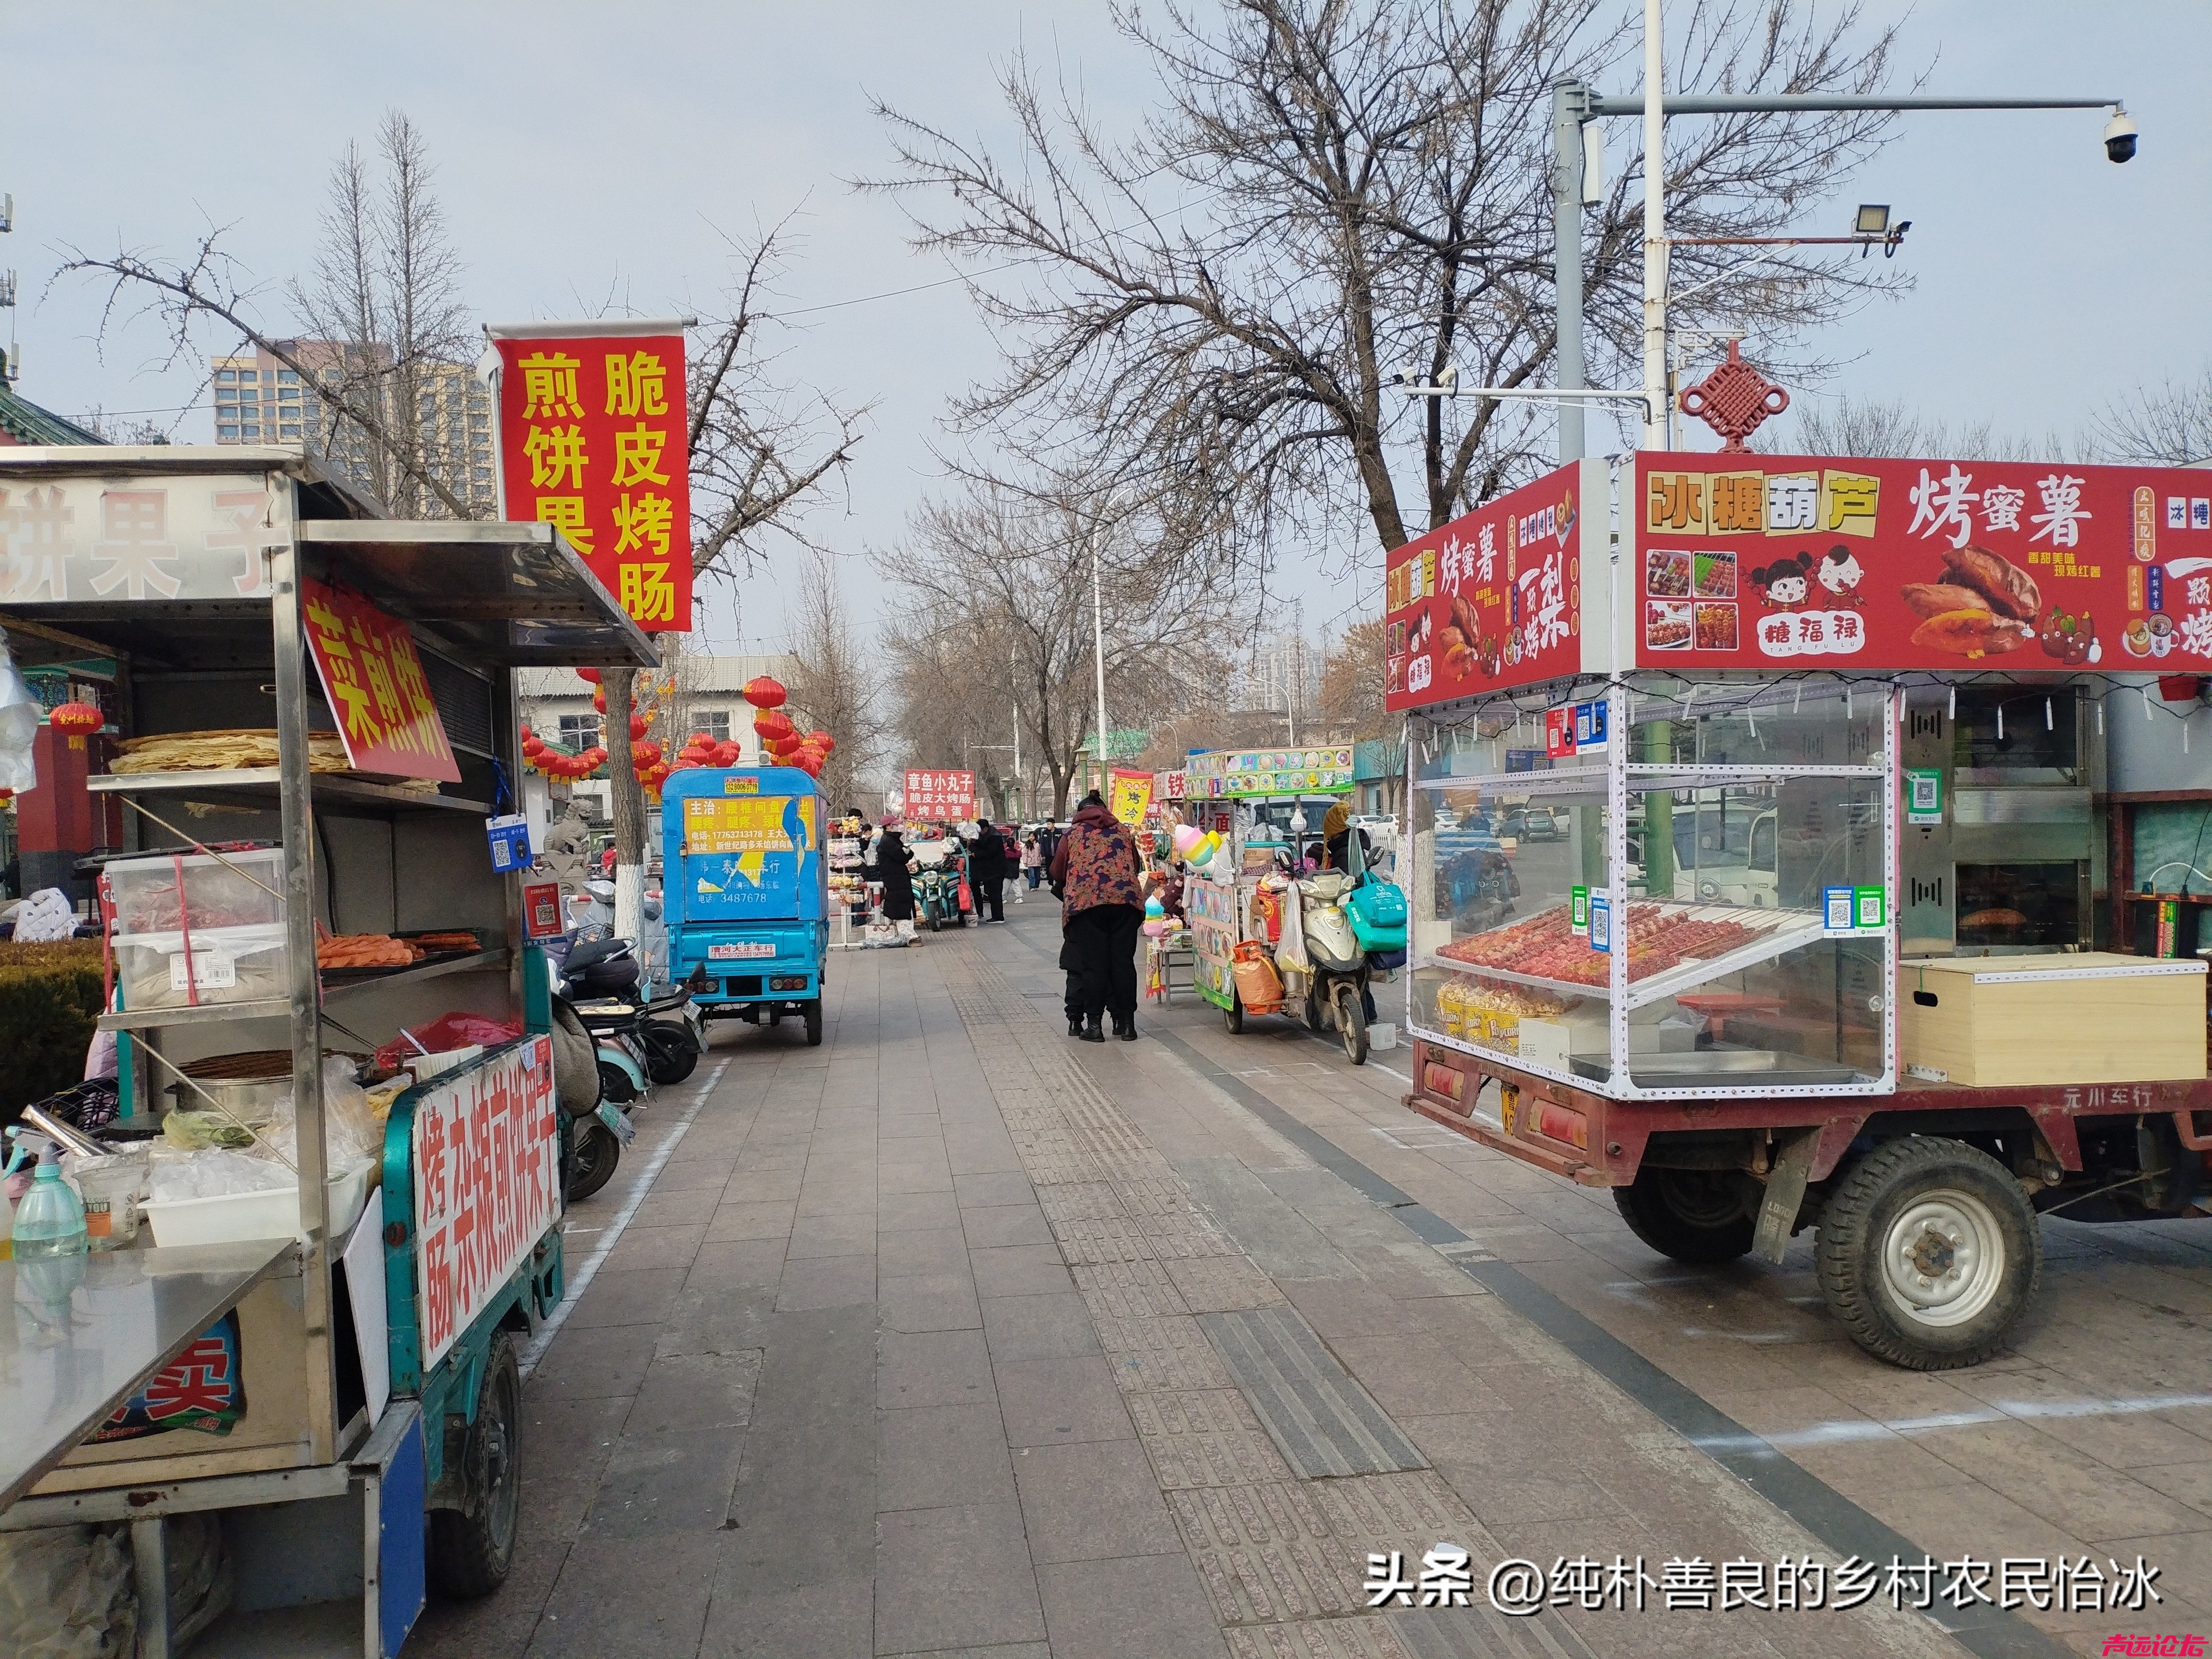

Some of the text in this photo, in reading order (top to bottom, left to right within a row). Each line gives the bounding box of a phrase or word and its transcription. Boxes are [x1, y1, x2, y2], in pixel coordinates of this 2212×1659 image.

[604, 350, 675, 622] 脆皮烤肠
[1651, 474, 1878, 531] 冰糖葫芦
[1907, 463, 2093, 549] 烤蜜薯
[1440, 522, 1498, 598] 烤蜜薯
[2028, 551, 2076, 564] 香甜美味
[2054, 564, 2101, 578] 现烤红薯
[1389, 550, 1435, 614] 冰糖葫芦
[1764, 615, 1858, 644] 糖福禄
[306, 596, 448, 762] 菜煎饼
[907, 772, 973, 792] 章鱼小丸子
[909, 792, 971, 804] 脆皮大烤肠
[917, 805, 963, 817] 烤鸟蛋
[720, 893, 766, 903] 3487678
[2064, 1087, 2153, 1107] 元川车行
[420, 1107, 454, 1354] 烤肠
